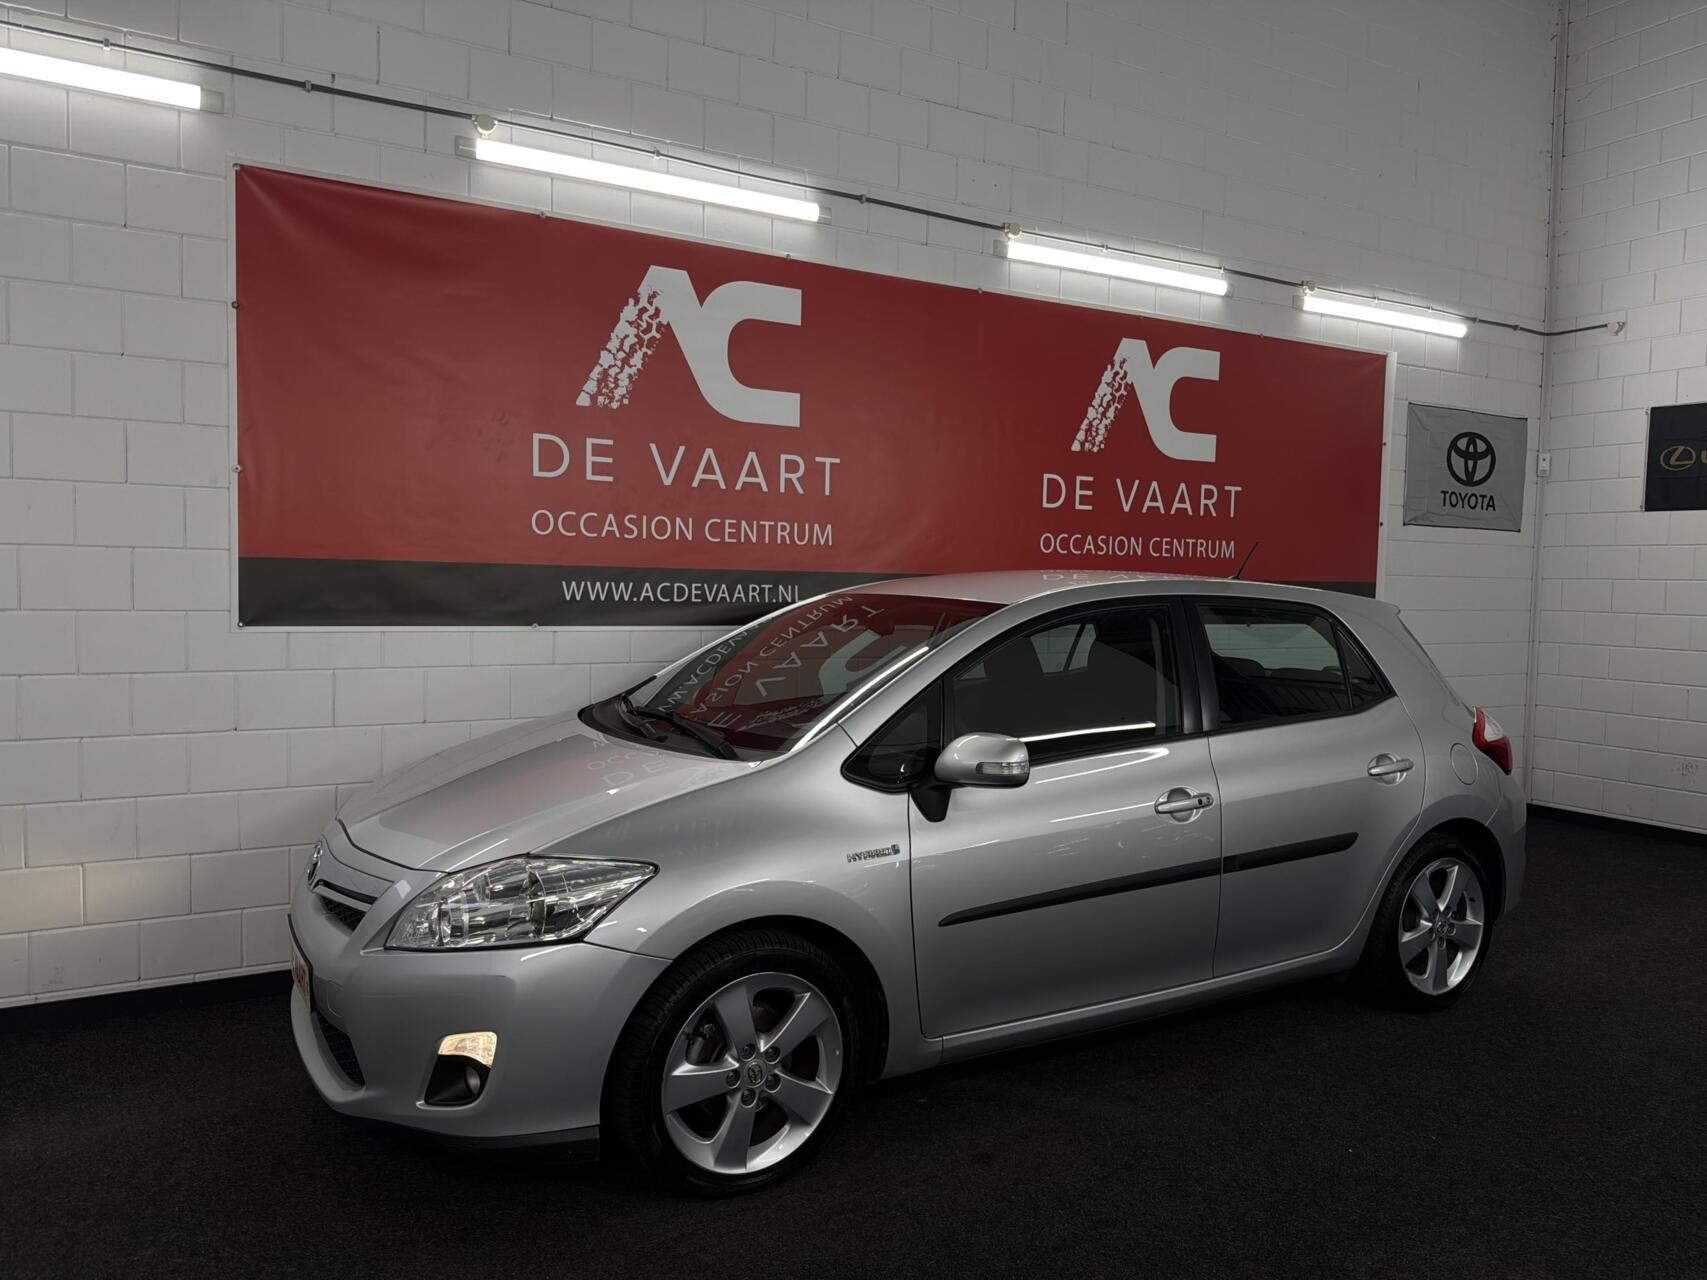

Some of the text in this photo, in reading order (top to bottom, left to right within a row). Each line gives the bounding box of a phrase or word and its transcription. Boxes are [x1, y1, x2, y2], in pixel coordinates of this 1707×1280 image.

[532, 433, 841, 496] DE VAART
[1042, 473, 1242, 518] DE VAART
[1440, 490, 1497, 512] TOYOTA
[531, 509, 833, 546] OCCASION CENTRUM
[1039, 533, 1236, 559] OCCASION CENTRUM
[561, 580, 800, 603] WWW.ACDEVAART.NL
